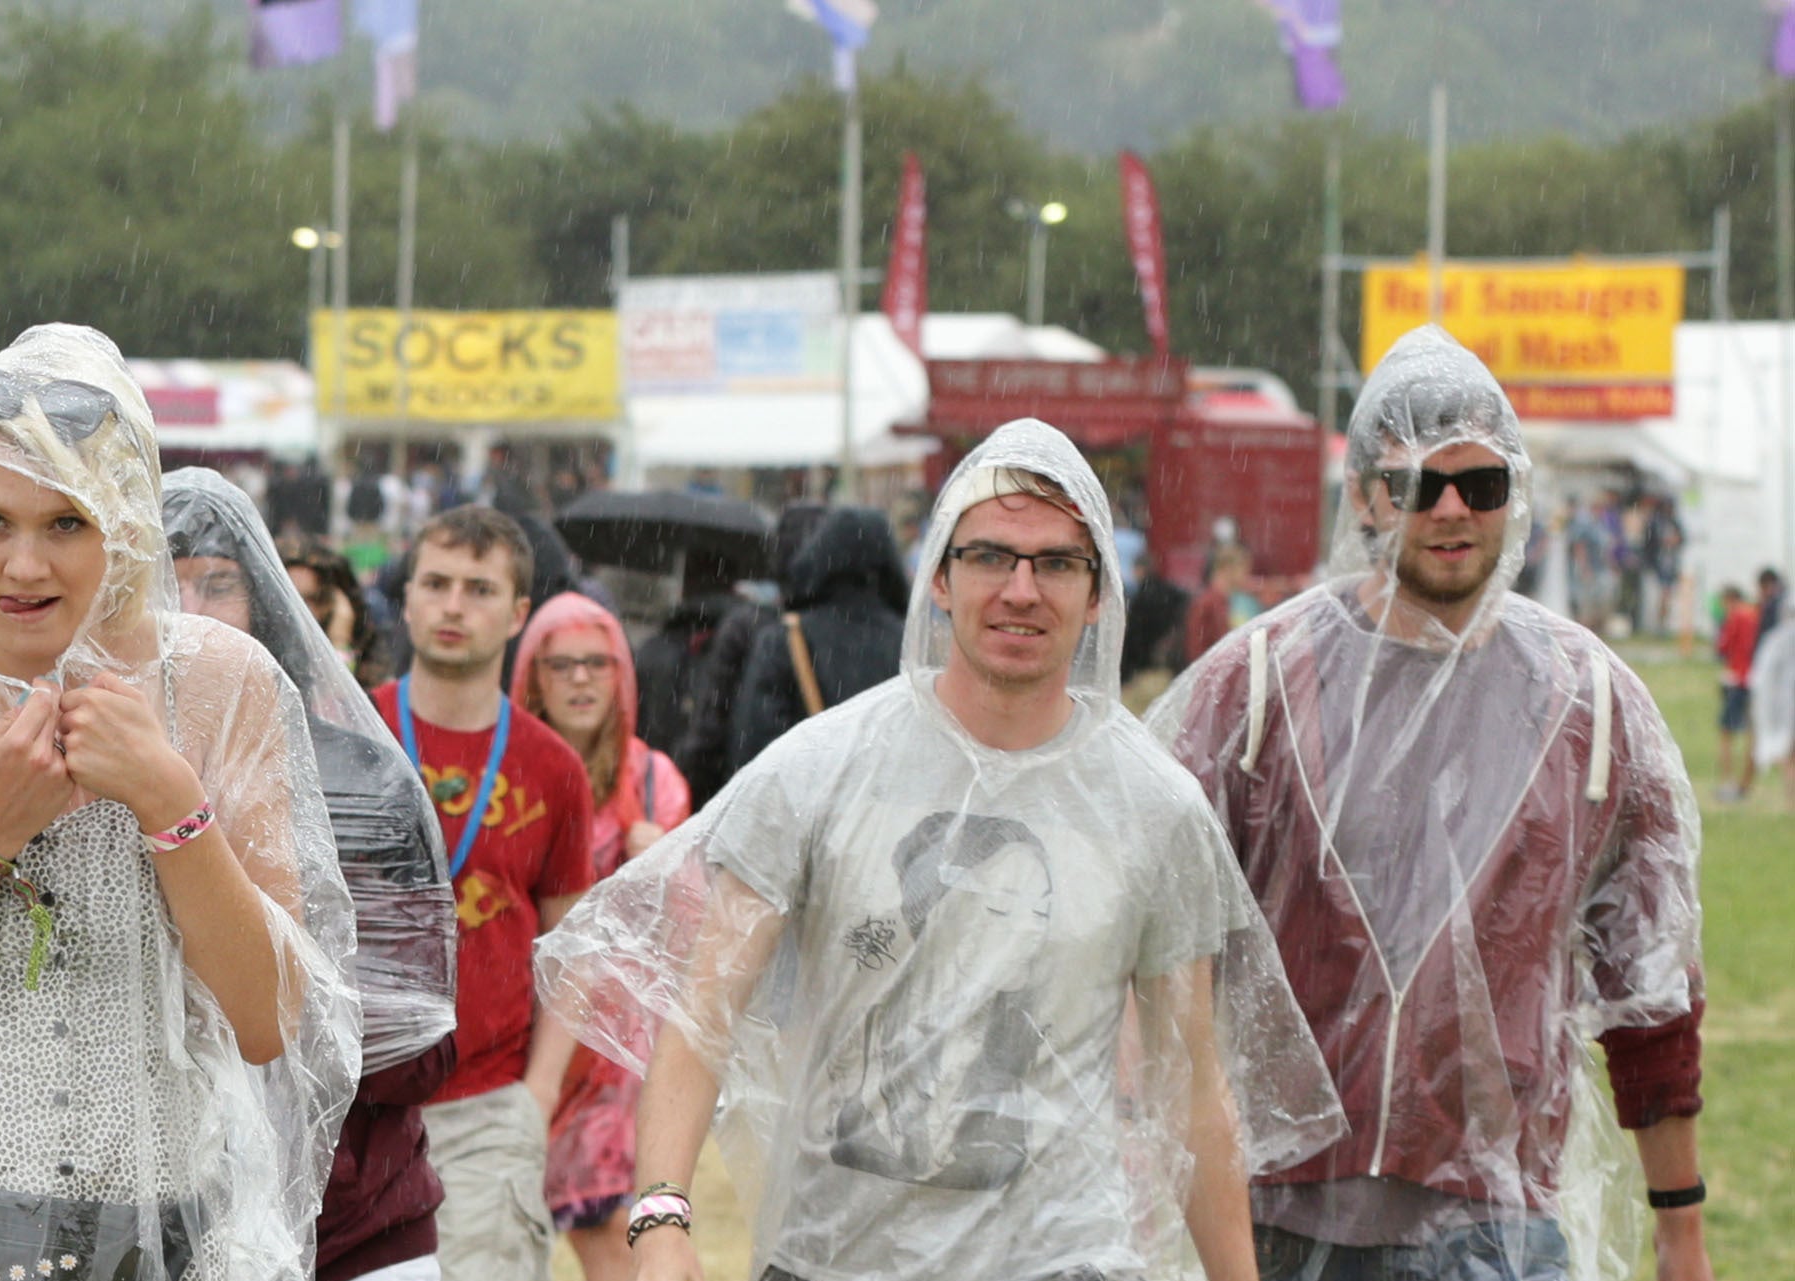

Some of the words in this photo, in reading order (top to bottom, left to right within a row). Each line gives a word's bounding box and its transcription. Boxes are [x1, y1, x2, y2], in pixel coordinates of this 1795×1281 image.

[1481, 278, 1665, 325] Sausages
[342, 317, 587, 374] SOCKS
[1516, 332, 1619, 369] Mash
